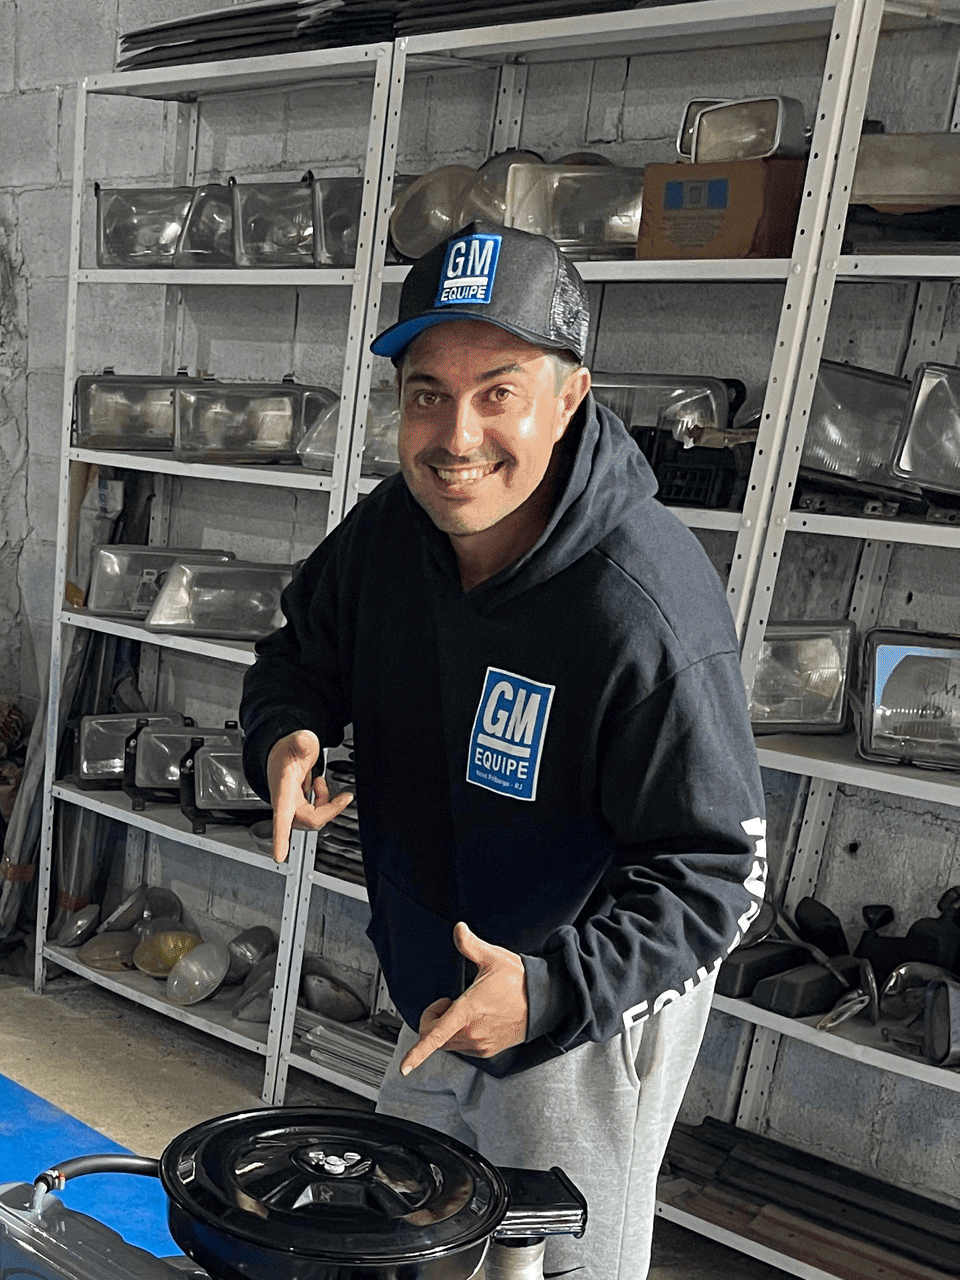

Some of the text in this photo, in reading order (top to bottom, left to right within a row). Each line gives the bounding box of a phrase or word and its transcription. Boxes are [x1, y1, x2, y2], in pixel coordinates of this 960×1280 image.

[447, 240, 494, 277] GM
[441, 286, 487, 301] EQUIPE
[483, 681, 541, 745] GM
[475, 747, 529, 779] EQUIPE
